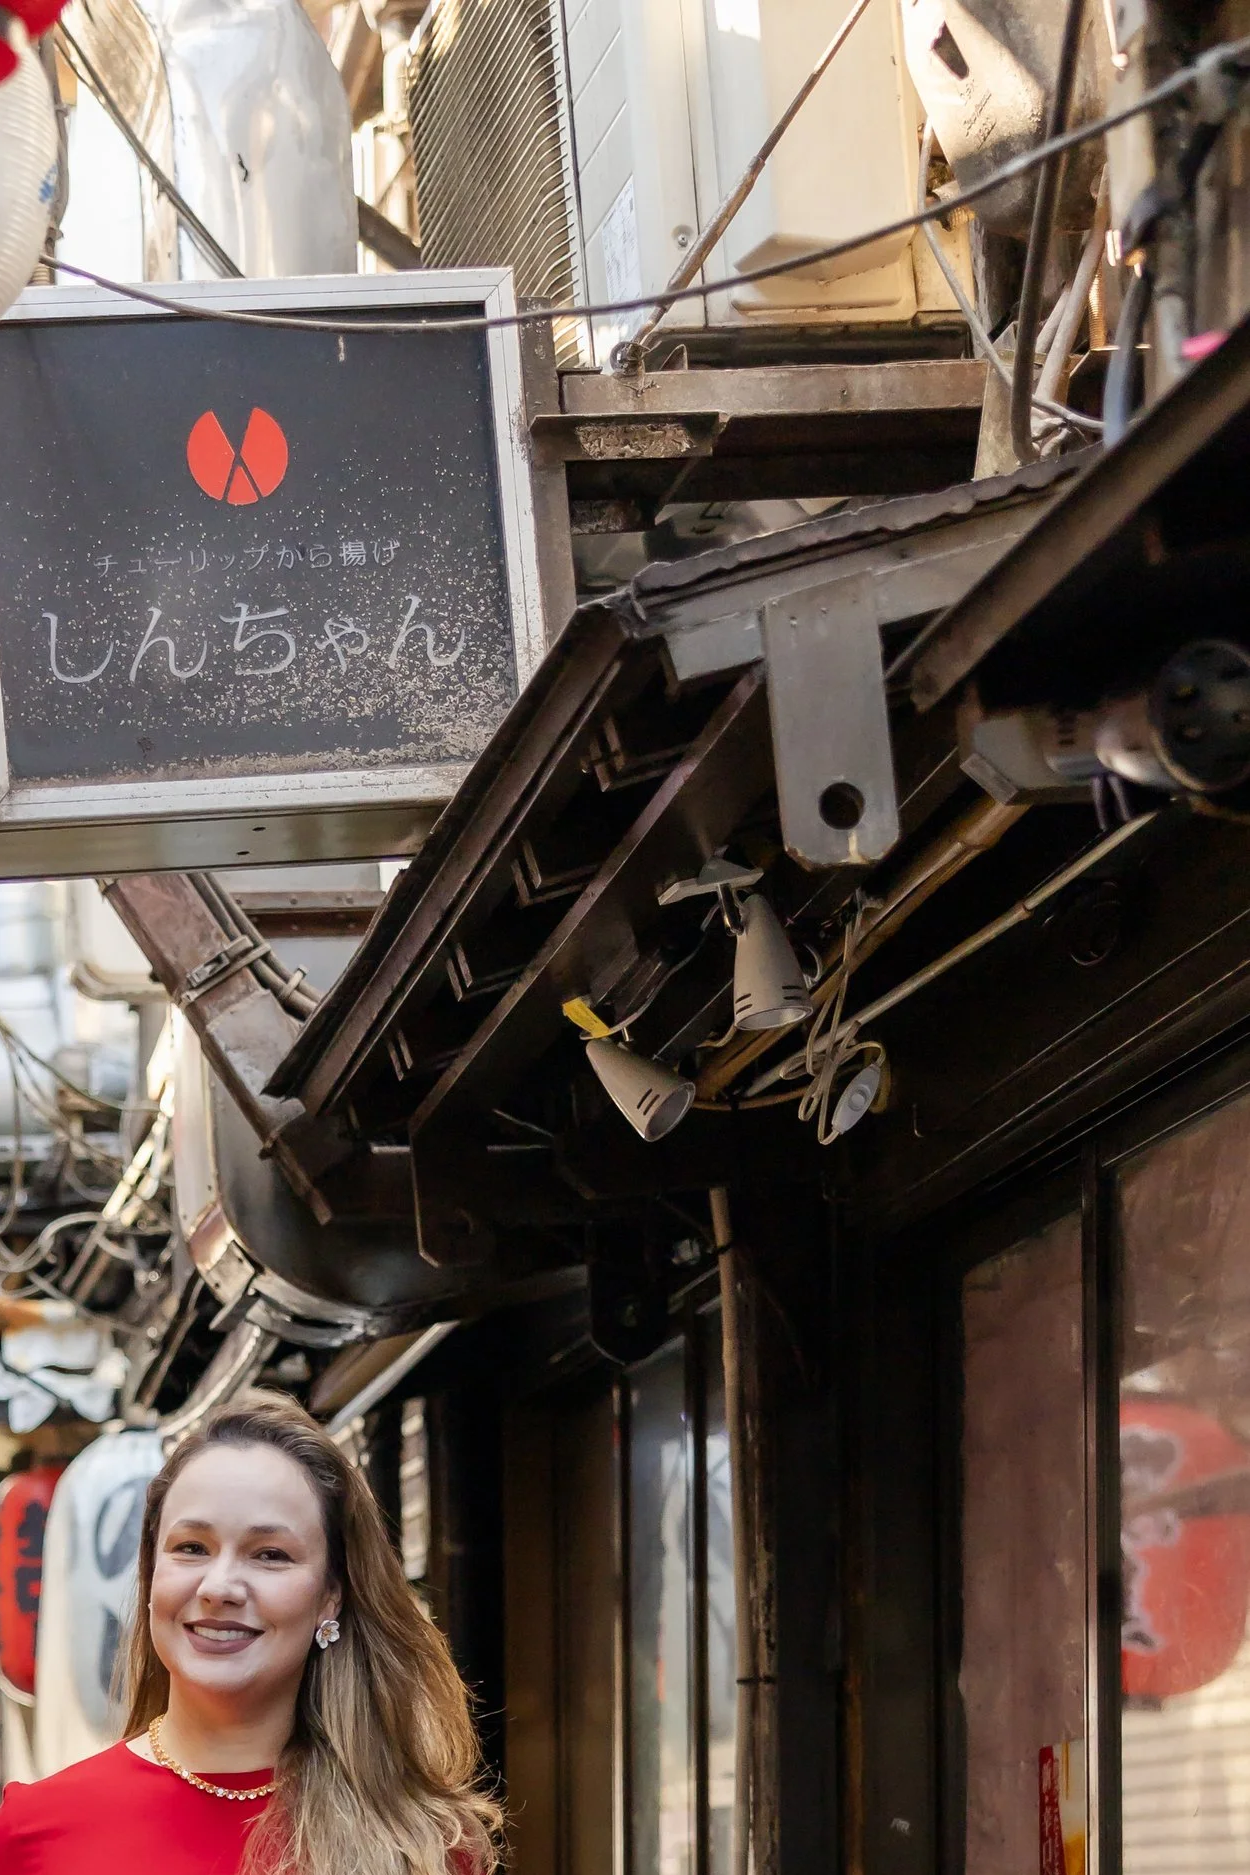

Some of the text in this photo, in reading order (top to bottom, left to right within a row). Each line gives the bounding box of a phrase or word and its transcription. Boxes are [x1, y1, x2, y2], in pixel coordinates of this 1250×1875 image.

[93, 539, 400, 578] チューリップから揚げ
[41, 594, 465, 684] しんちゃん
